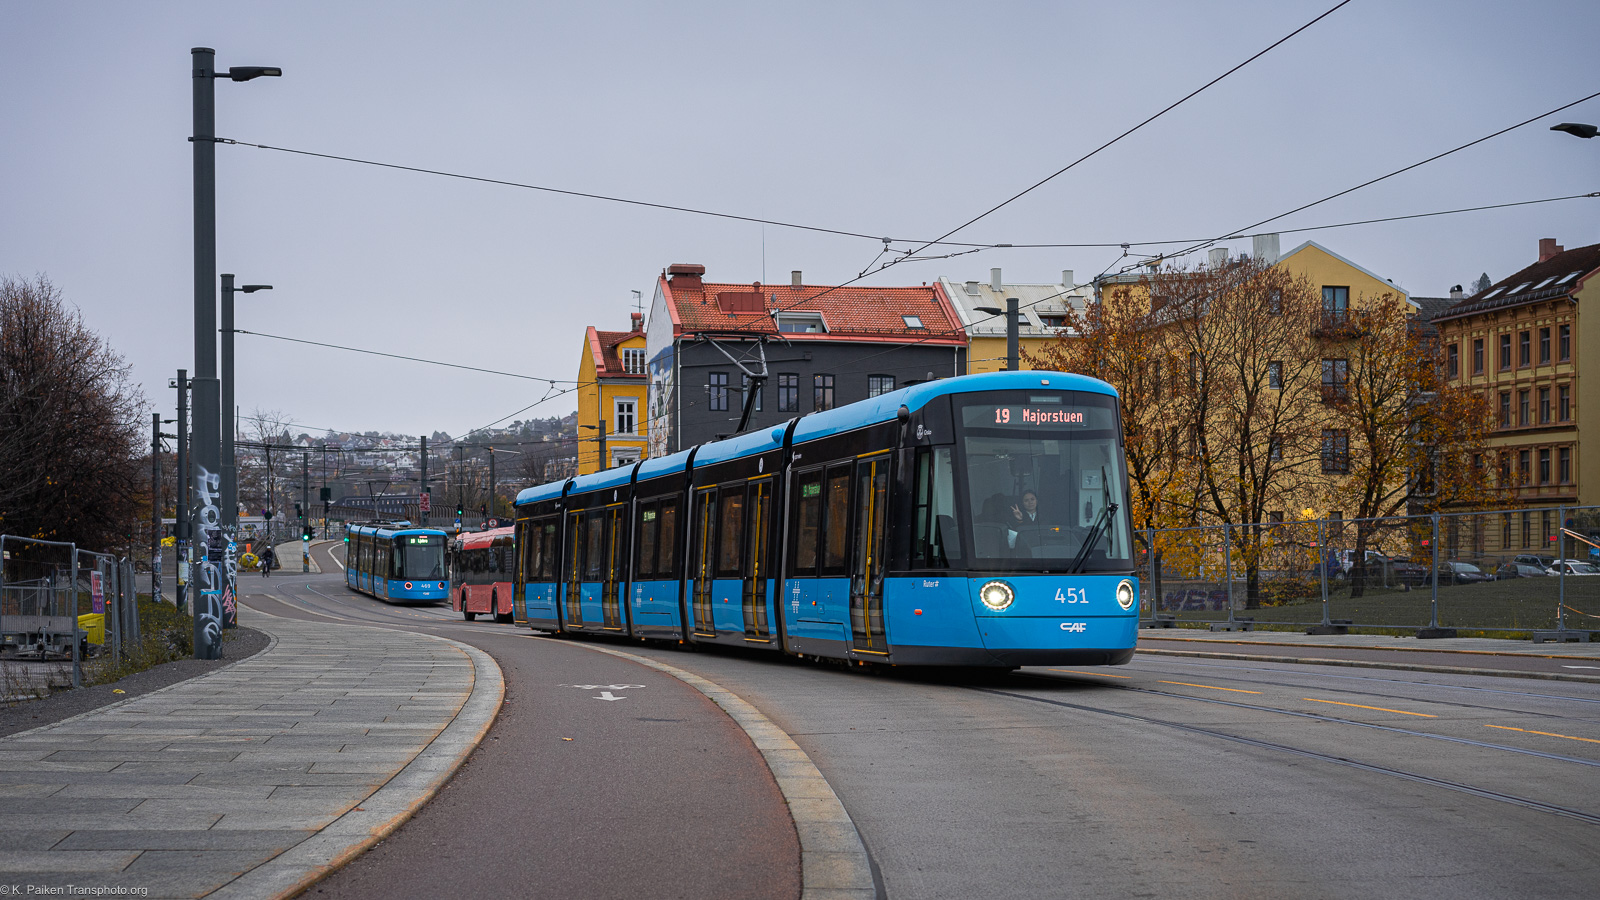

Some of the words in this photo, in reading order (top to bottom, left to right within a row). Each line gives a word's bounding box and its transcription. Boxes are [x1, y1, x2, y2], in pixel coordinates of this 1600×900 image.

[994, 408, 1010, 424] 19
[1022, 408, 1083, 426] Majorstuen
[1054, 587, 1090, 604] 451
[1060, 622, 1087, 633] CAF
